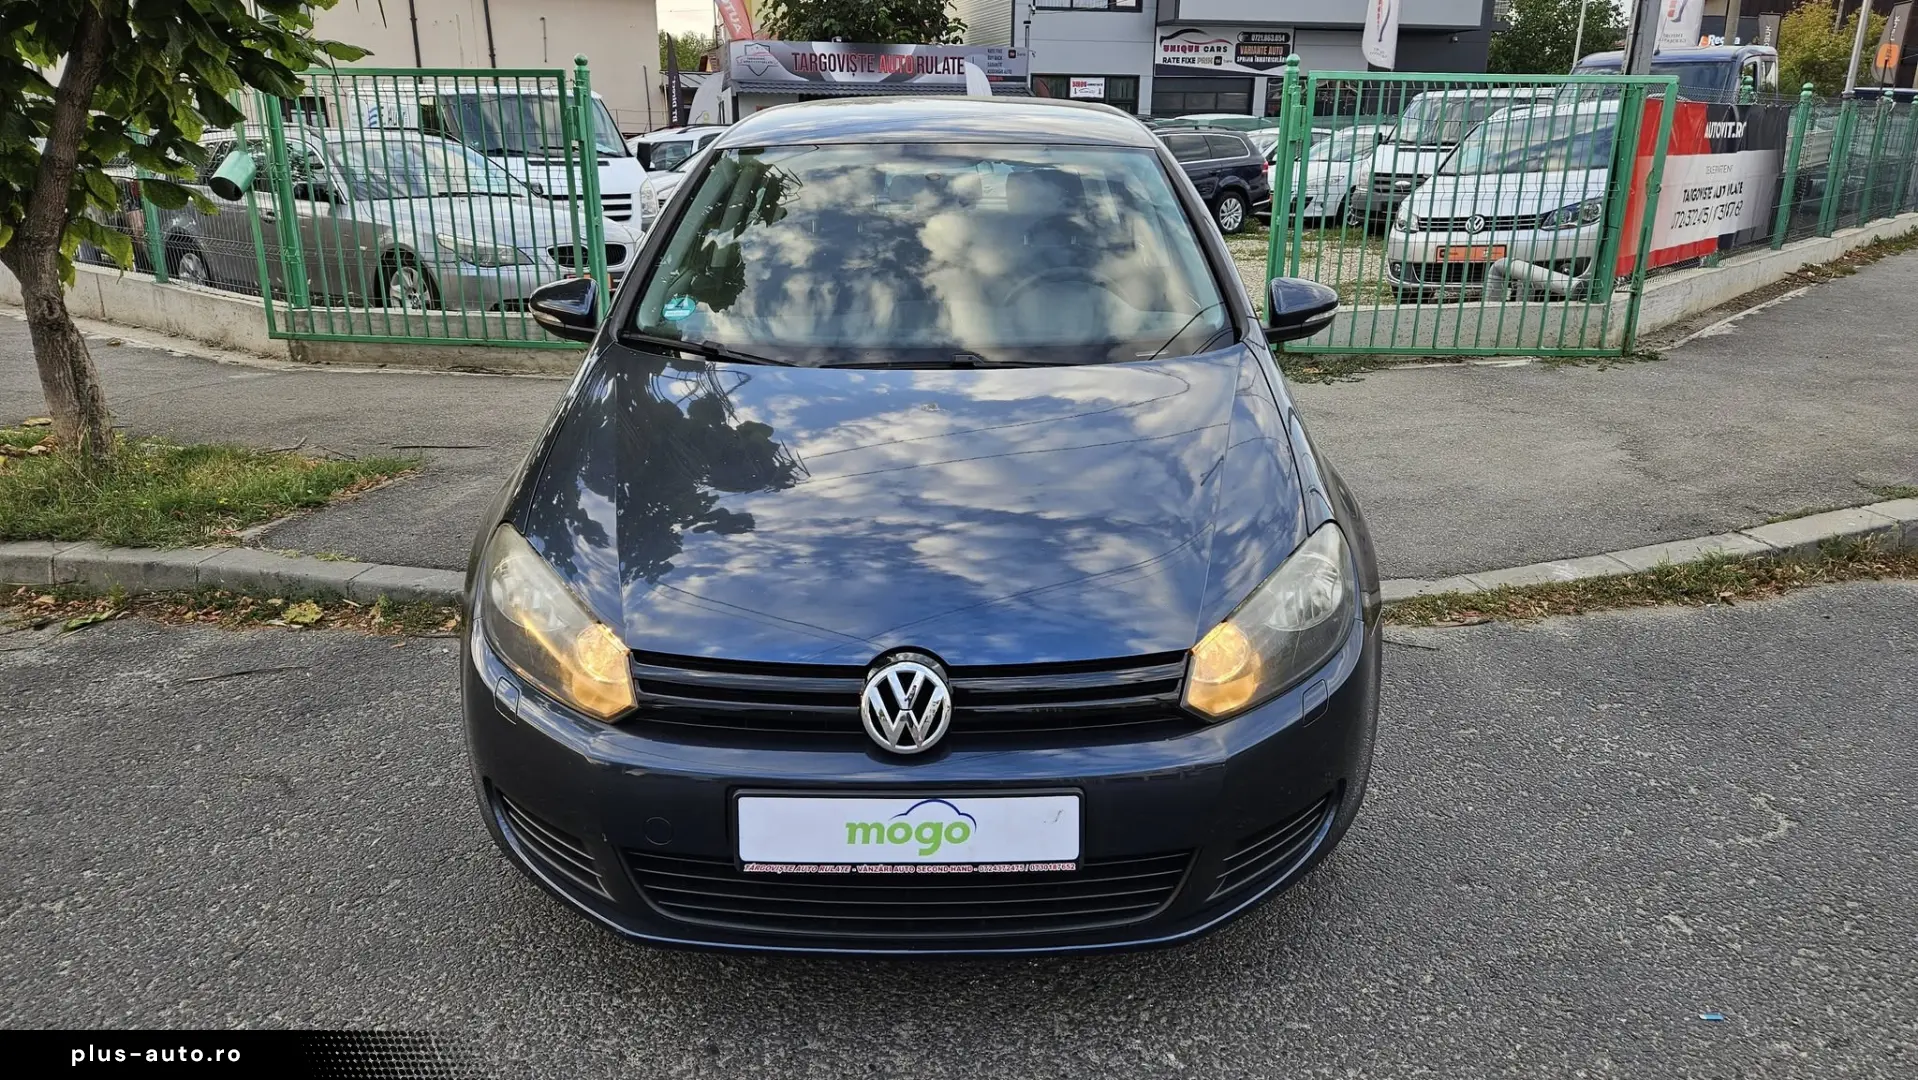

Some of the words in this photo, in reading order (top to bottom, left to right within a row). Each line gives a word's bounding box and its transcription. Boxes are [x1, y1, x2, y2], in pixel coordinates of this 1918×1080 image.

[1203, 45, 1228, 53] CARS
[1268, 46, 1284, 55] AUTO
[878, 53, 914, 74] AUTO
[916, 55, 965, 75] RULATE
[845, 820, 972, 857] mogo
[794, 865, 818, 873] AUTO
[818, 865, 851, 873] RULATE
[893, 865, 915, 873] AUTO
